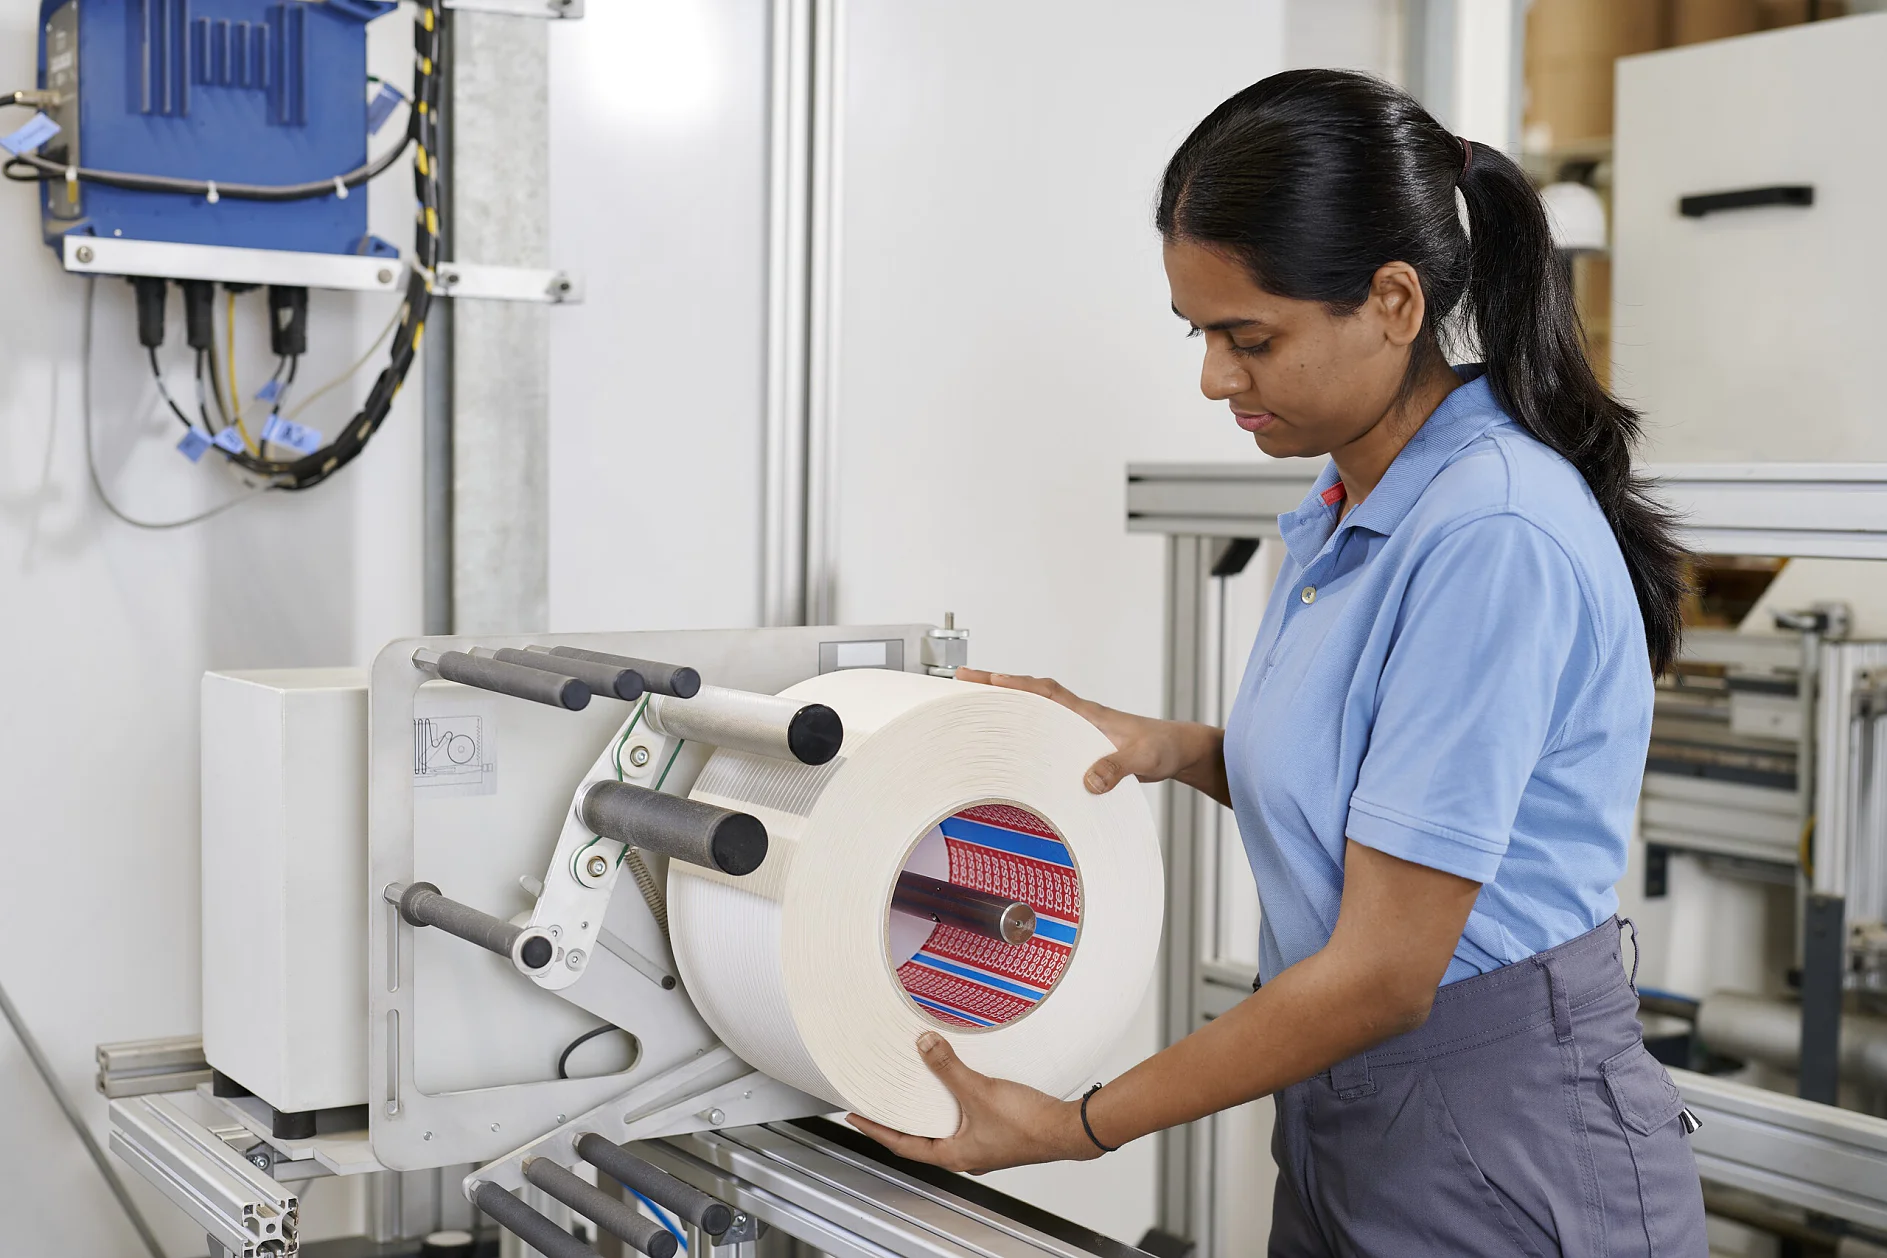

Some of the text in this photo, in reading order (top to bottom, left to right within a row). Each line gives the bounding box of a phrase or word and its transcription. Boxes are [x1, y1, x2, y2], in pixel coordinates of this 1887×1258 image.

[983, 854, 992, 892] tesa
[992, 856, 1000, 895] tesa
[1000, 858, 1009, 897] tesa
[1009, 861, 1018, 899] tesa
[1018, 863, 1027, 902] tesa
[1027, 866, 1035, 904] tesa
[1035, 868, 1044, 907] tesa
[1044, 870, 1053, 910] tesa
[1053, 872, 1062, 912] tesa
[1063, 875, 1071, 915] tesa
[1007, 943, 1029, 973] tesa
[1014, 945, 1036, 975] tesa
[1022, 947, 1044, 978] tesa
[1030, 949, 1052, 980] tesa
[1038, 951, 1060, 983] tesa
[1045, 954, 1067, 986] tesa
